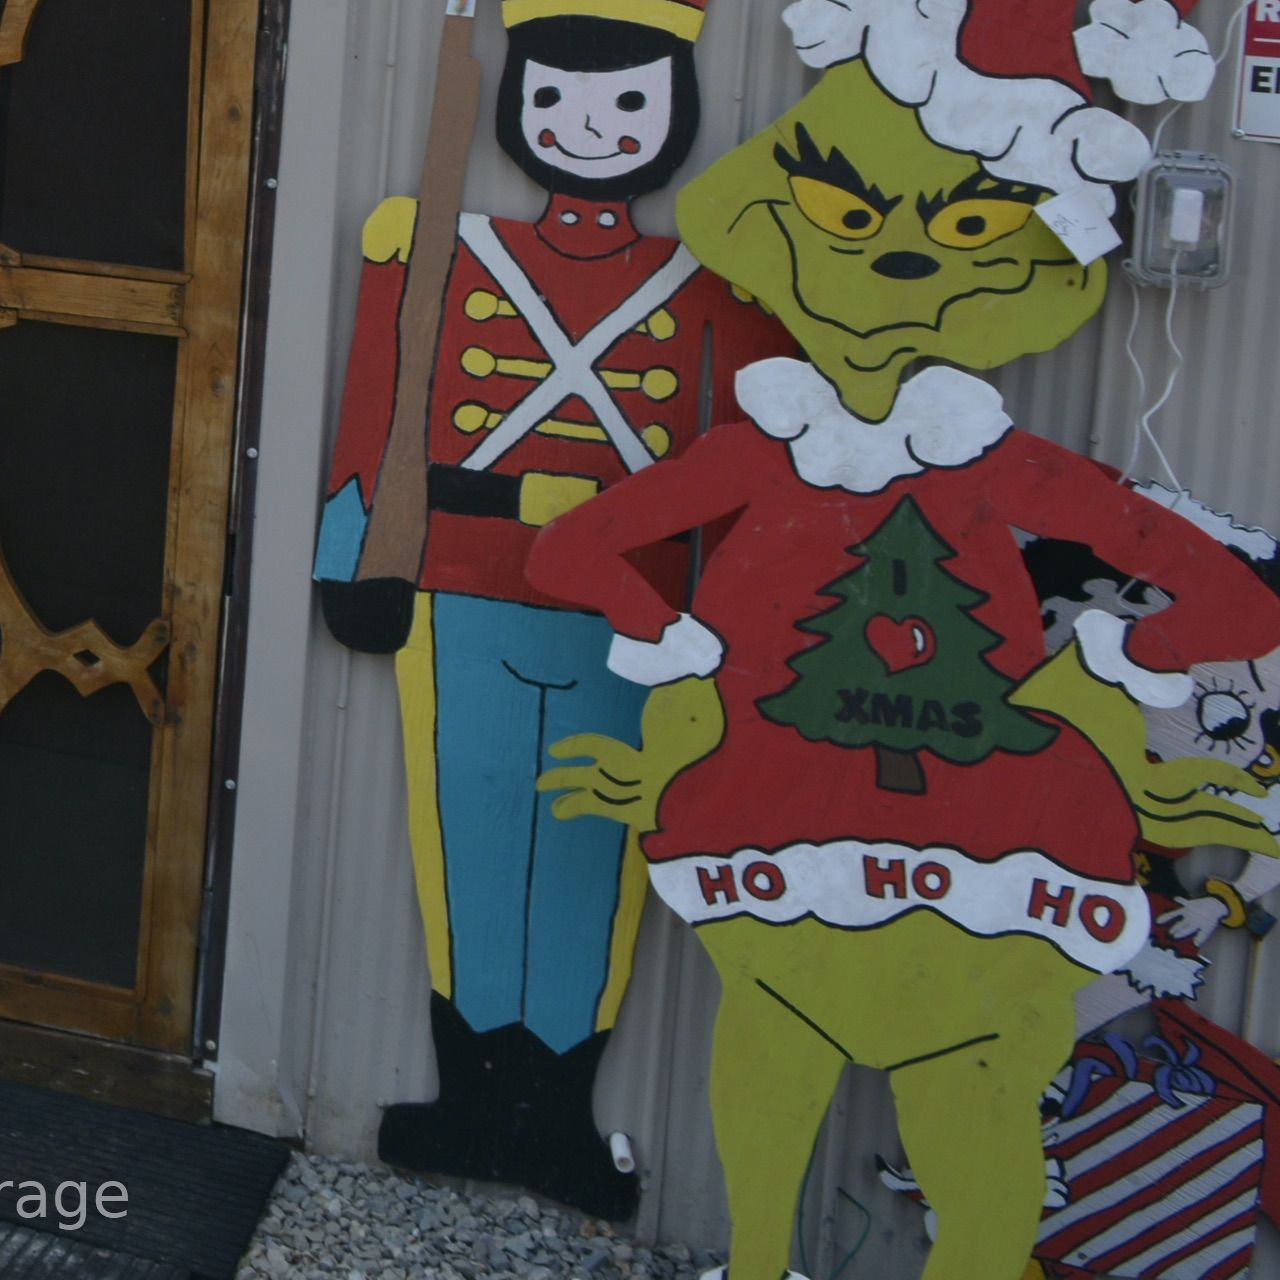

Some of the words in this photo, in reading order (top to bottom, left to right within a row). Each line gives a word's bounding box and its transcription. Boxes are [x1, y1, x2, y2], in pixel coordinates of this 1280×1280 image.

[892, 559, 908, 596] I
[834, 687, 983, 738] XMAS
[696, 860, 787, 907] HO
[861, 853, 953, 901] HO
[1027, 876, 1128, 944] HO
